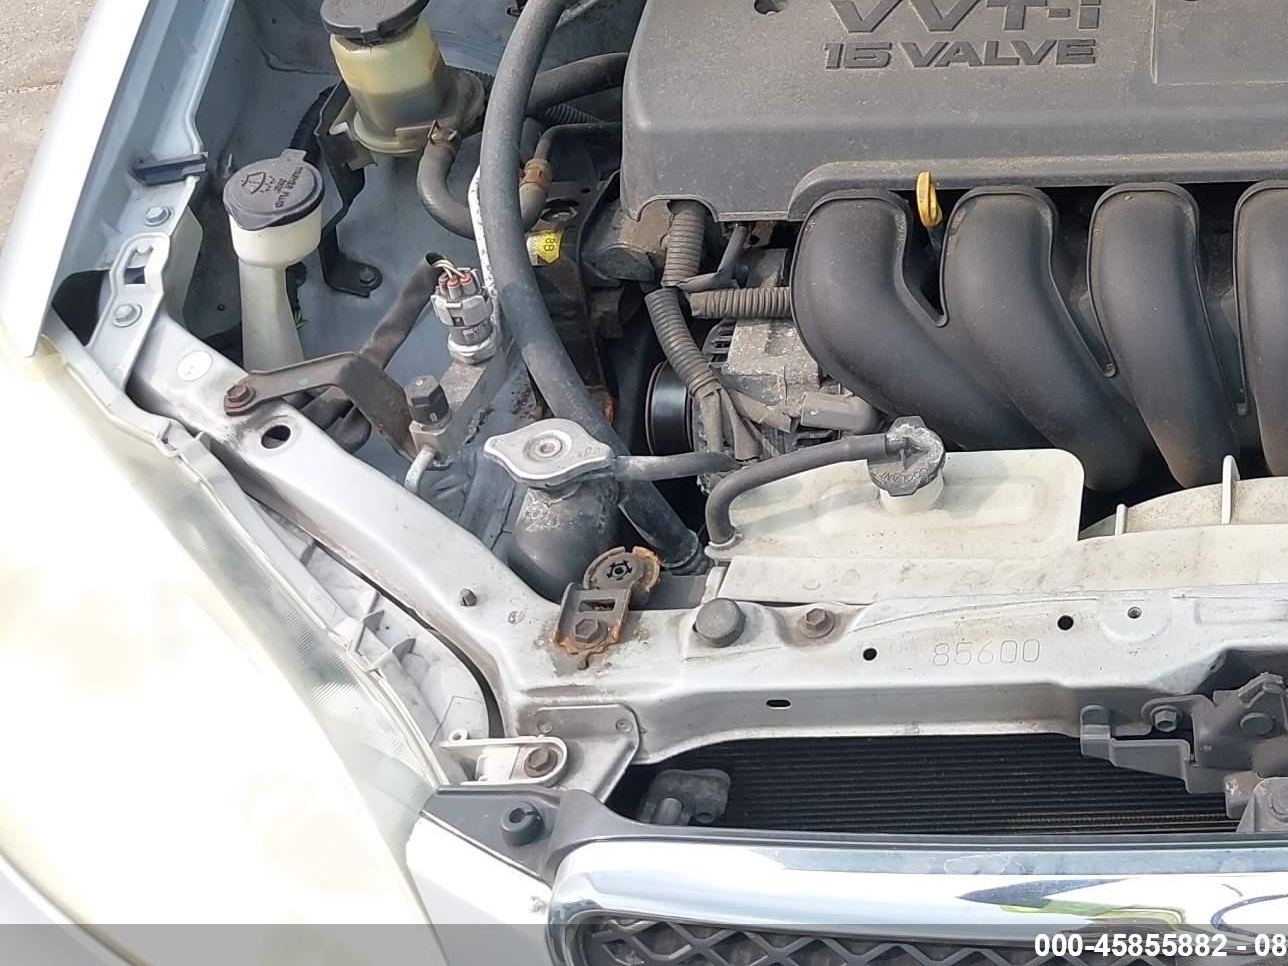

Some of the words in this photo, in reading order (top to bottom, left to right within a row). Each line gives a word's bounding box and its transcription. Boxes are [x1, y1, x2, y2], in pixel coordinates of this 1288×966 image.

[824, 42, 892, 69] 16
[901, 39, 1097, 68] VALVE
[932, 638, 1041, 666] 85600
